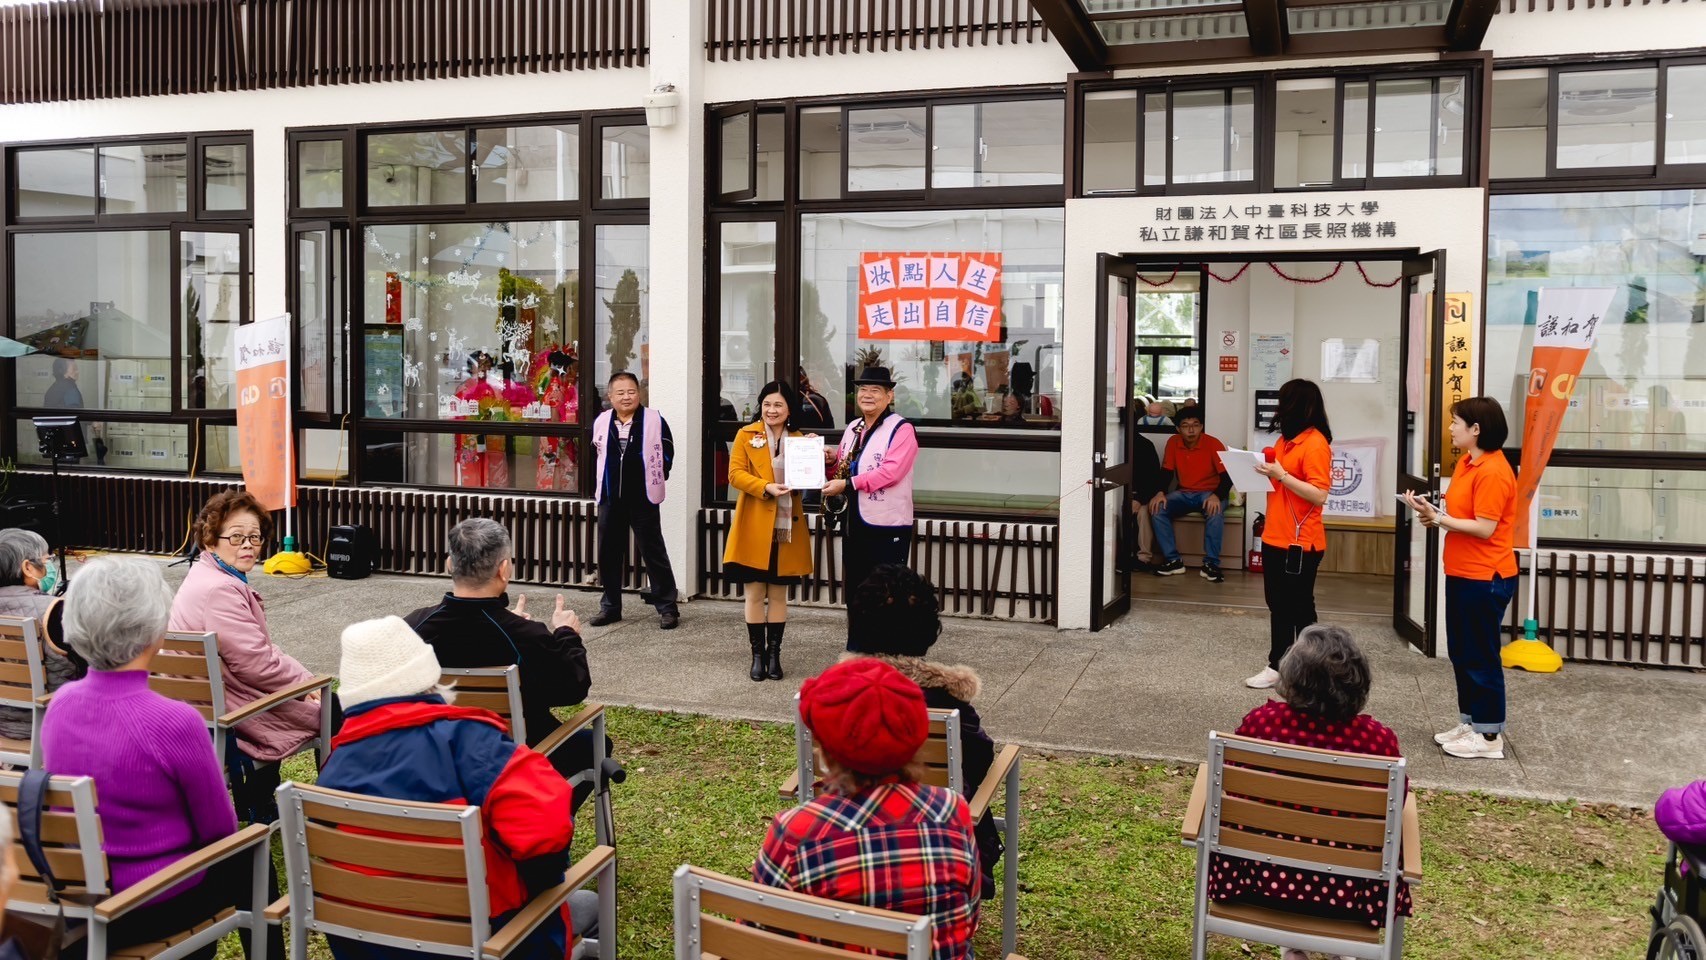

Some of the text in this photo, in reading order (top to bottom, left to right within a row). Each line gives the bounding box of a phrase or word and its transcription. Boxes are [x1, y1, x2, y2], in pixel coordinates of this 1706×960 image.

[1155, 200, 1380, 221] 財團法人中臺科技大學
[1139, 221, 1398, 242] 私立謙和賀社區長照機構
[871, 301, 989, 327] 走出自信
[329, 553, 351, 562] MIPRO
